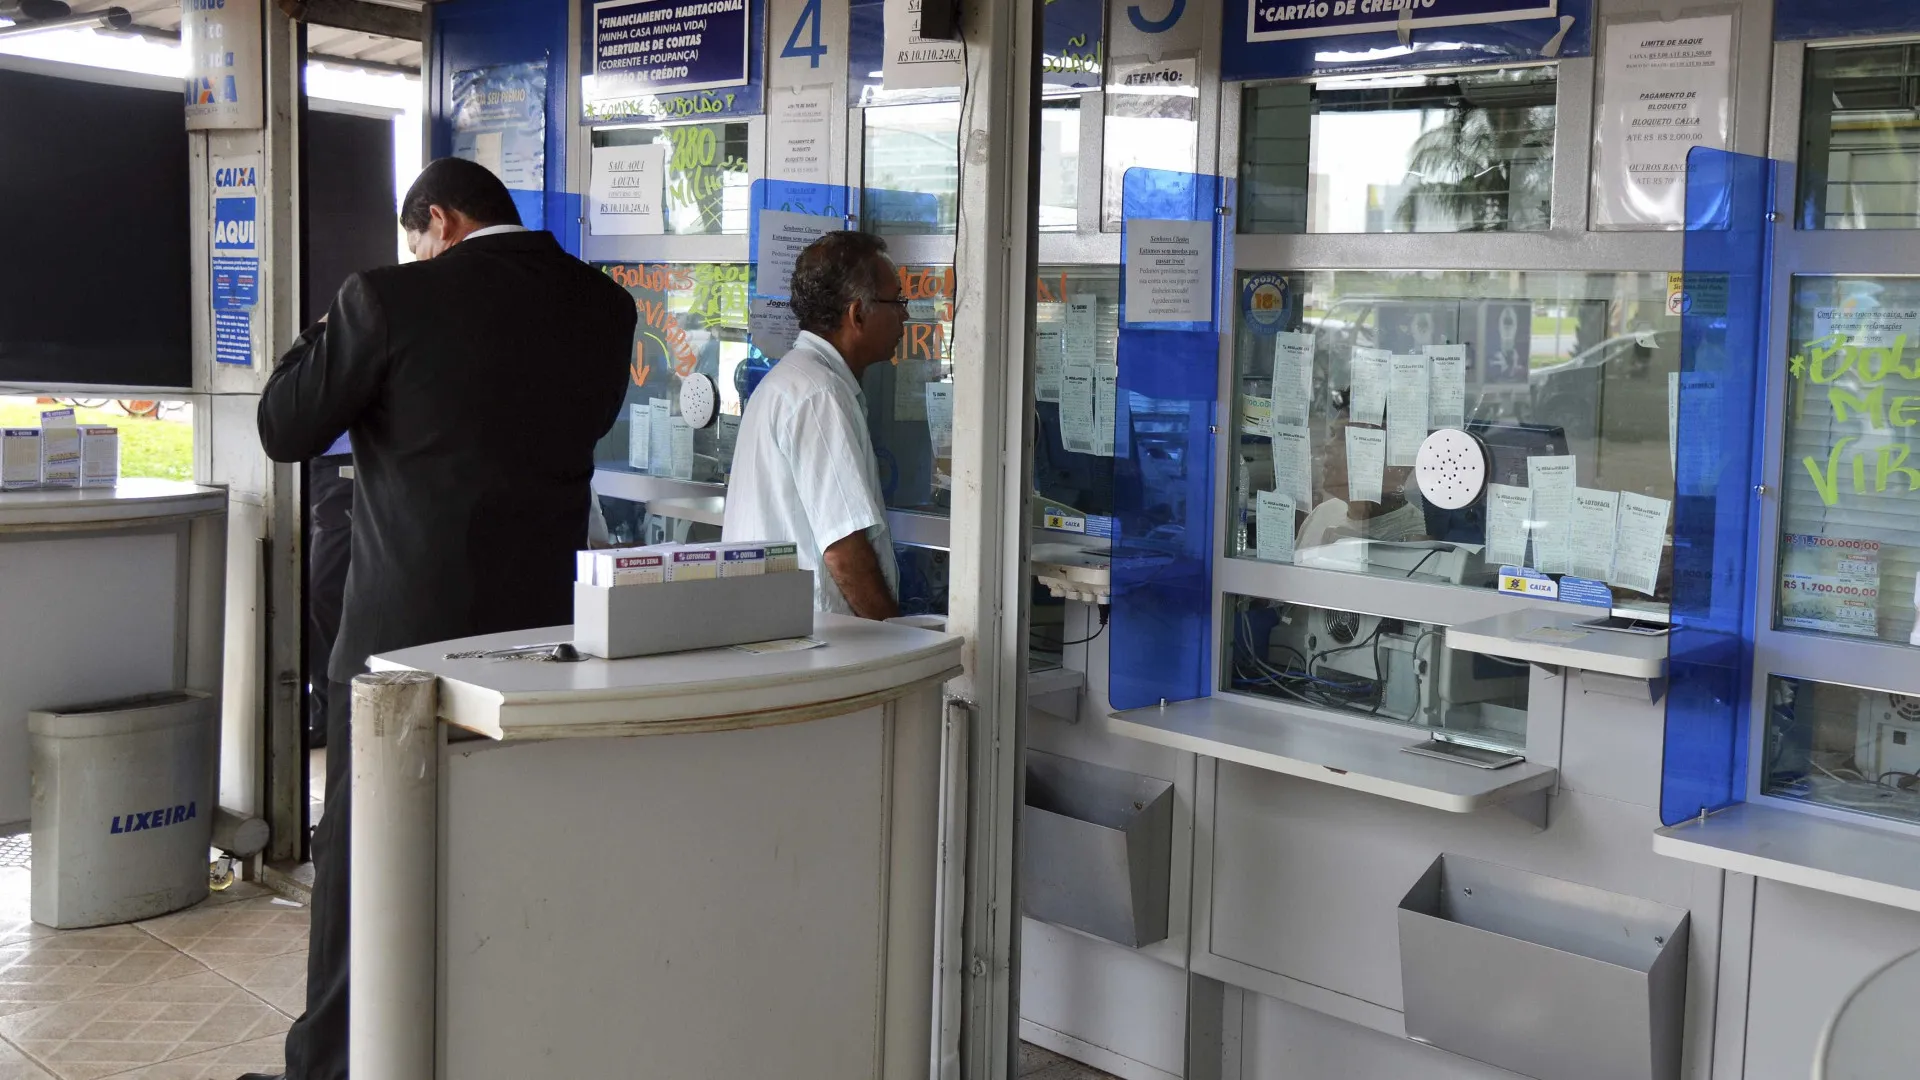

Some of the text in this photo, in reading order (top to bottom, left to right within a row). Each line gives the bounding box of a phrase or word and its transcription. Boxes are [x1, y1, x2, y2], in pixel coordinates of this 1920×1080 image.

[675, 0, 743, 19] HABITACIONAL
[1333, 2, 1355, 16] DE
[599, 19, 707, 44] (MINHA CASA MINHA VIDA)
[780, 0, 827, 68] 4
[651, 38, 664, 50] DE
[665, 34, 702, 49] CONTAS
[1677, 37, 1704, 45] SAQUE
[598, 56, 642, 72] (CORRENTE
[649, 49, 699, 64] POUPANÇA)
[911, 48, 961, 61] 10.110.248,1
[636, 70, 649, 82] DE
[650, 65, 689, 81] CRÉDITO
[1124, 68, 1183, 86] ATENÇÃO:
[1639, 92, 1685, 100] PAGAMENTO
[1631, 117, 1701, 126] BLOQUETO CAIXA
[215, 167, 256, 187] CAIXA
[215, 220, 254, 244] AQUI
[1250, 275, 1286, 292] APOSTAR
[1904, 310, 1917, 318] não
[1828, 384, 1920, 430] ME
[1802, 536, 1880, 551] 1.700.000,00
[1529, 583, 1552, 592] CAIXA
[1783, 580, 1877, 597] R$ 1.700.000,00
[110, 802, 197, 834] LIXEIRA
